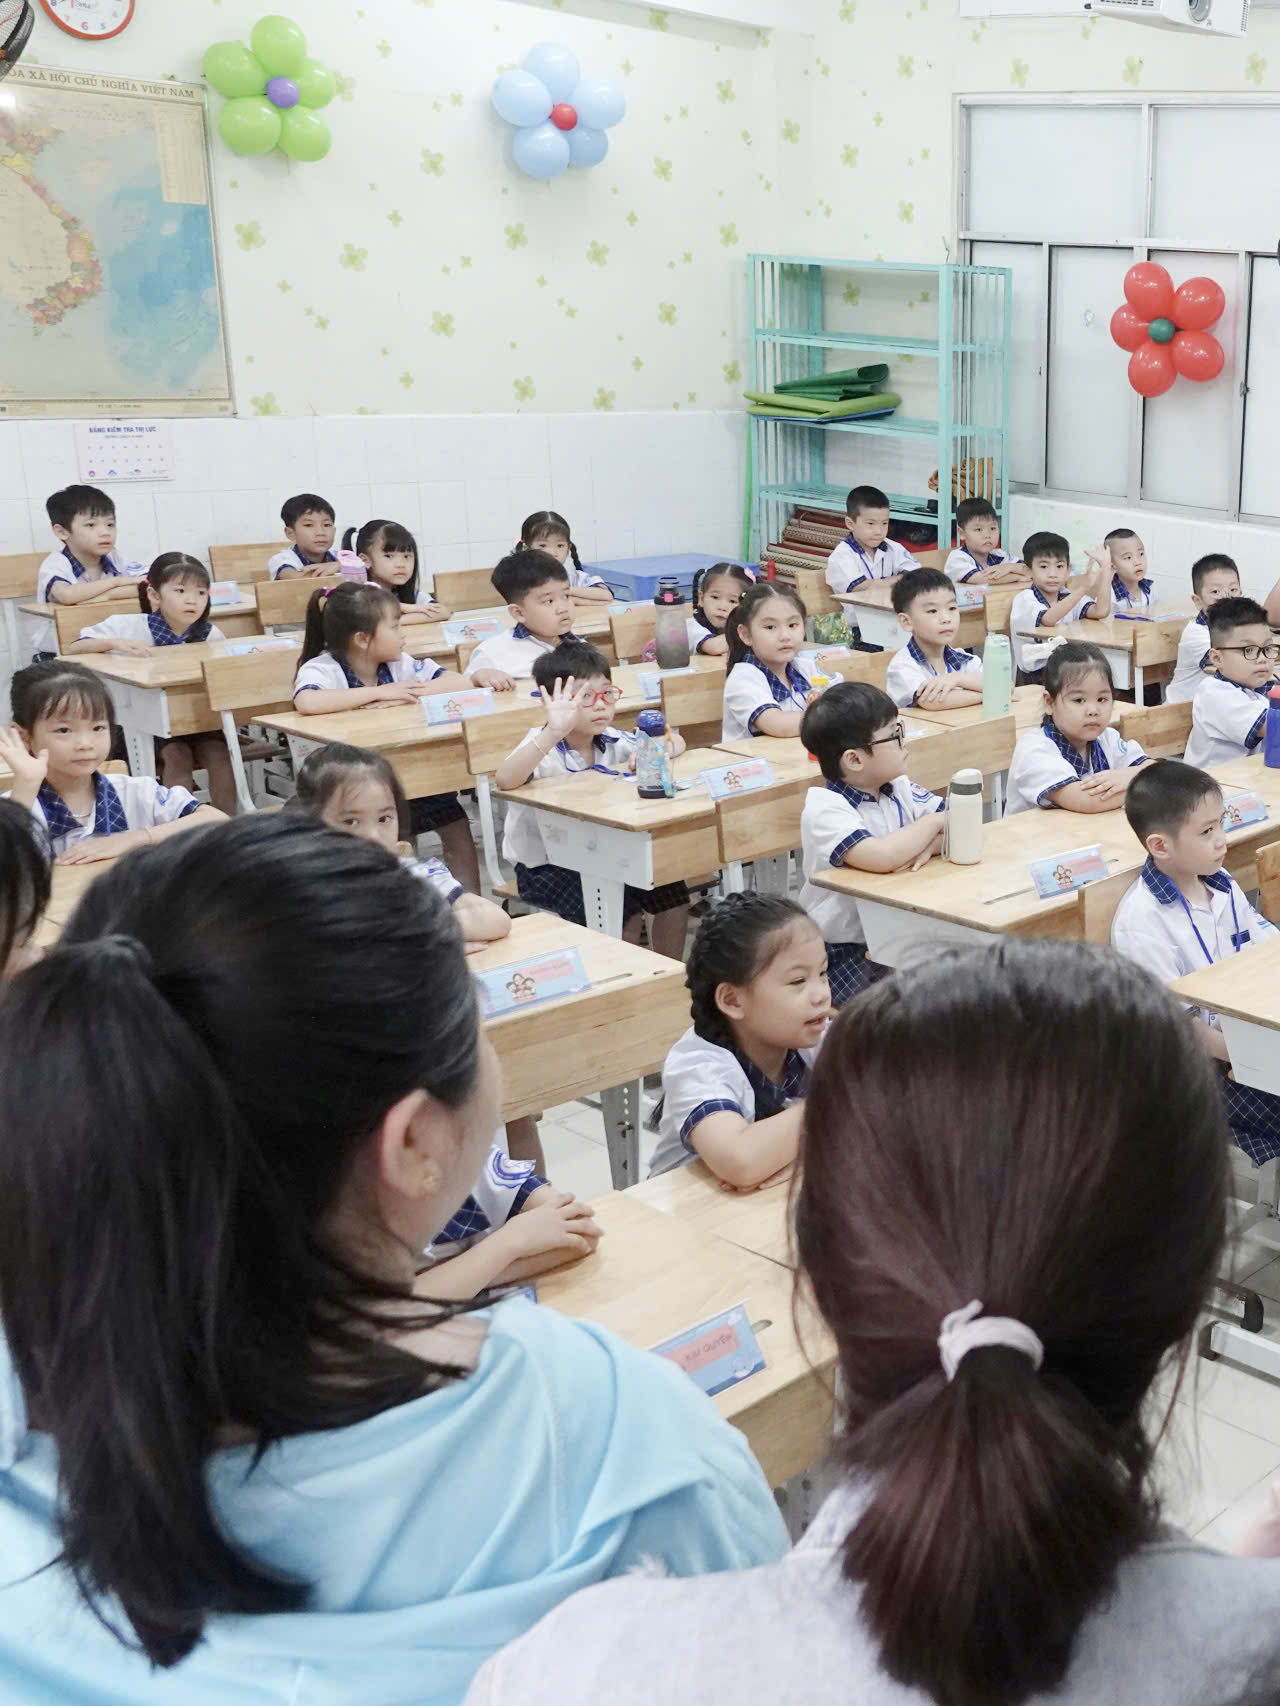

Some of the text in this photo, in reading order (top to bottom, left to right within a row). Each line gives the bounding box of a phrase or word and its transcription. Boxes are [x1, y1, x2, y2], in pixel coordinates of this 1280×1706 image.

[81, 21, 88, 31] 6
[73, 74, 98, 87] CHỦ
[169, 87, 194, 98] NAM
